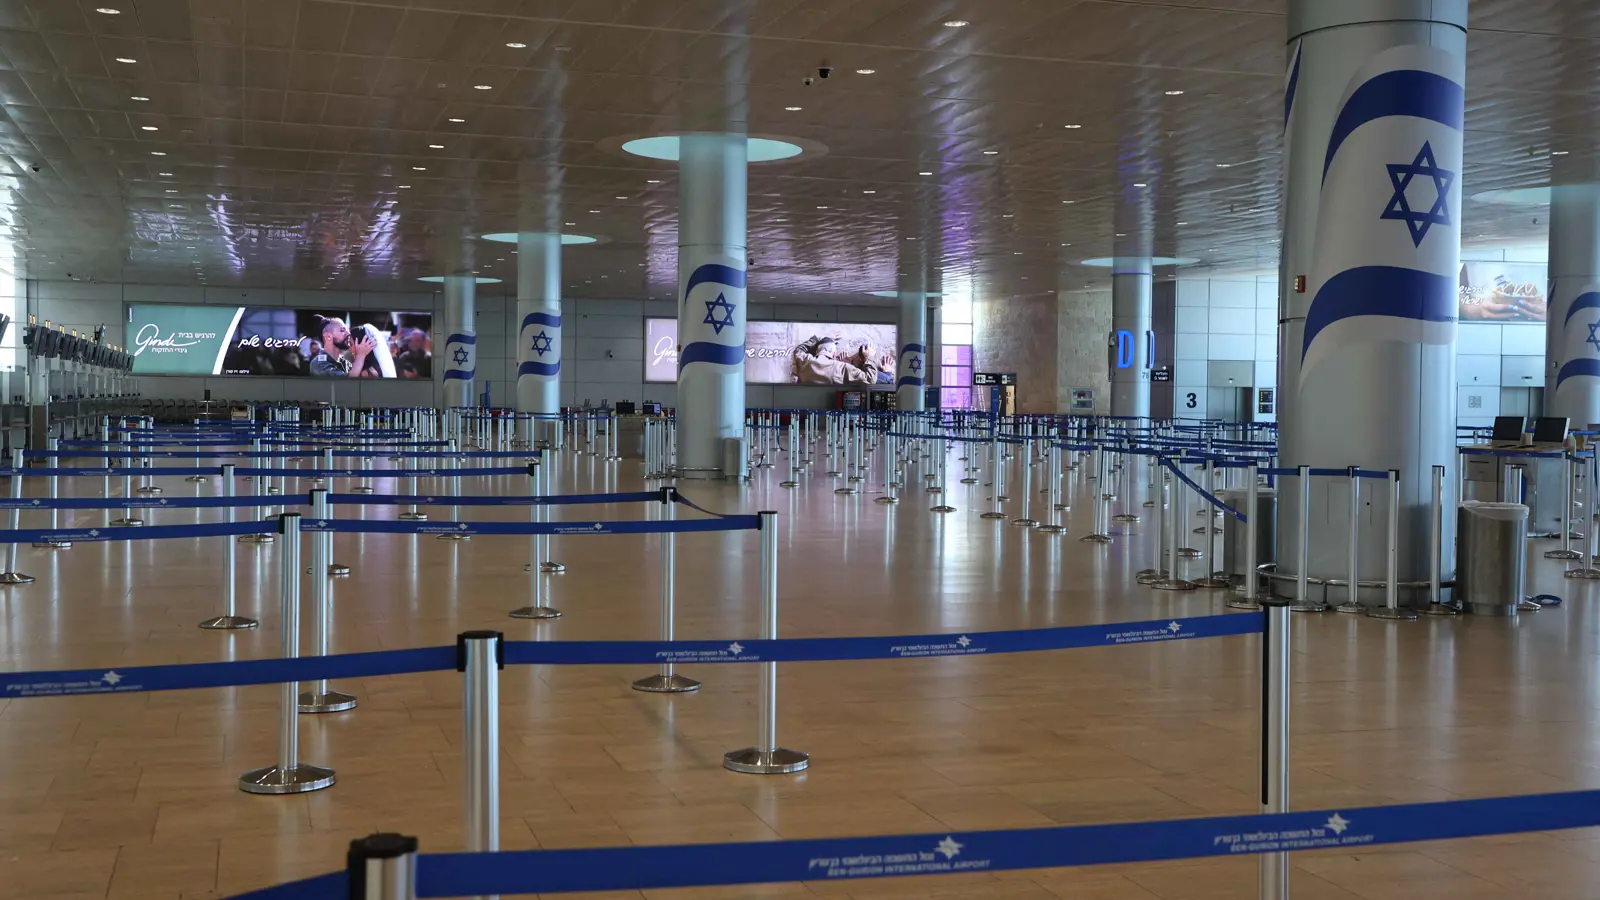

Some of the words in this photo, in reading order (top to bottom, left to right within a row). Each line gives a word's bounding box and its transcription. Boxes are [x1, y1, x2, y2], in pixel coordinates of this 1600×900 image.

[237, 334, 260, 348] שלם
[264, 336, 307, 348] להרגיש
[758, 346, 794, 358] להרגיש
[1116, 330, 1134, 369] D
[1186, 392, 1197, 409] 3
